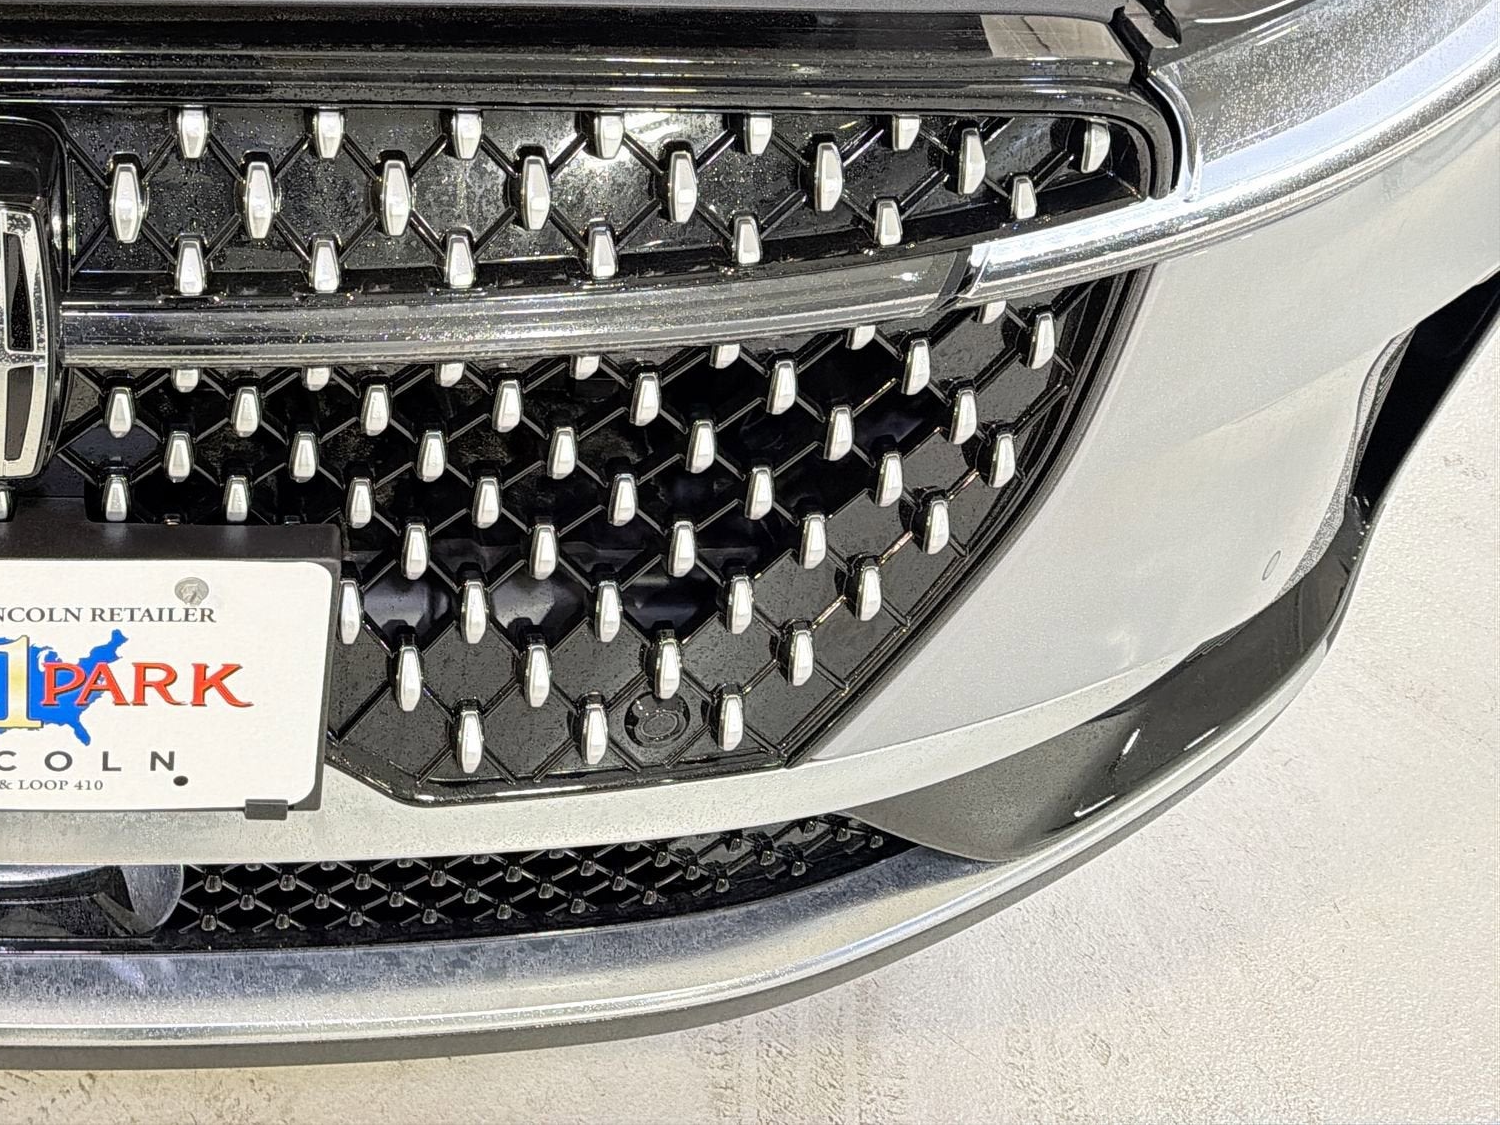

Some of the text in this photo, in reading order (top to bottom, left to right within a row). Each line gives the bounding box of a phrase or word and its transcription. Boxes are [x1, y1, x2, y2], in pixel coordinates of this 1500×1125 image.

[90, 607, 218, 624] RETAILER
[42, 661, 254, 709] PARK
[17, 780, 70, 791] LOOP
[72, 780, 105, 792] 410
